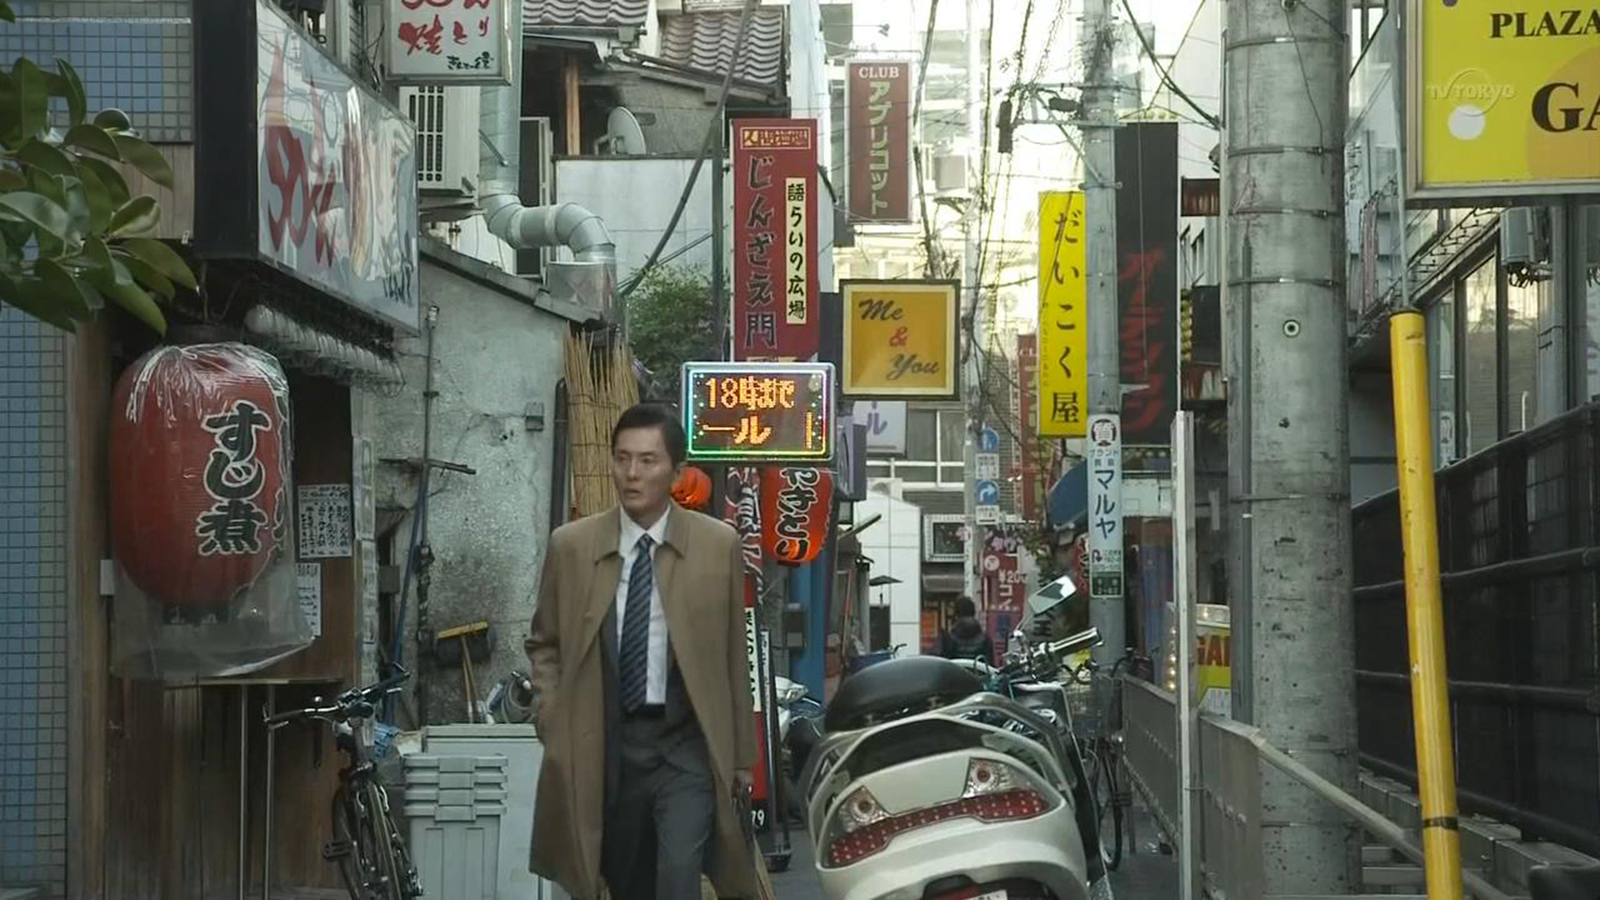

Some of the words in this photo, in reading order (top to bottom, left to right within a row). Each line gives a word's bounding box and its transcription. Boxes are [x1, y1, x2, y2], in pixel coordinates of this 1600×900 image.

[859, 66, 899, 79] CLUB
[868, 81, 890, 216] アプリコット
[745, 154, 776, 350] じんざえ門
[787, 182, 805, 322] 語らいの広場
[858, 297, 904, 322] Me
[889, 325, 909, 349] &
[1050, 210, 1082, 424] だいこく屋
[886, 354, 940, 381] You
[195, 400, 272, 556] すじ煮
[774, 467, 819, 560] やきとり
[1095, 469, 1117, 541] マルヤ
